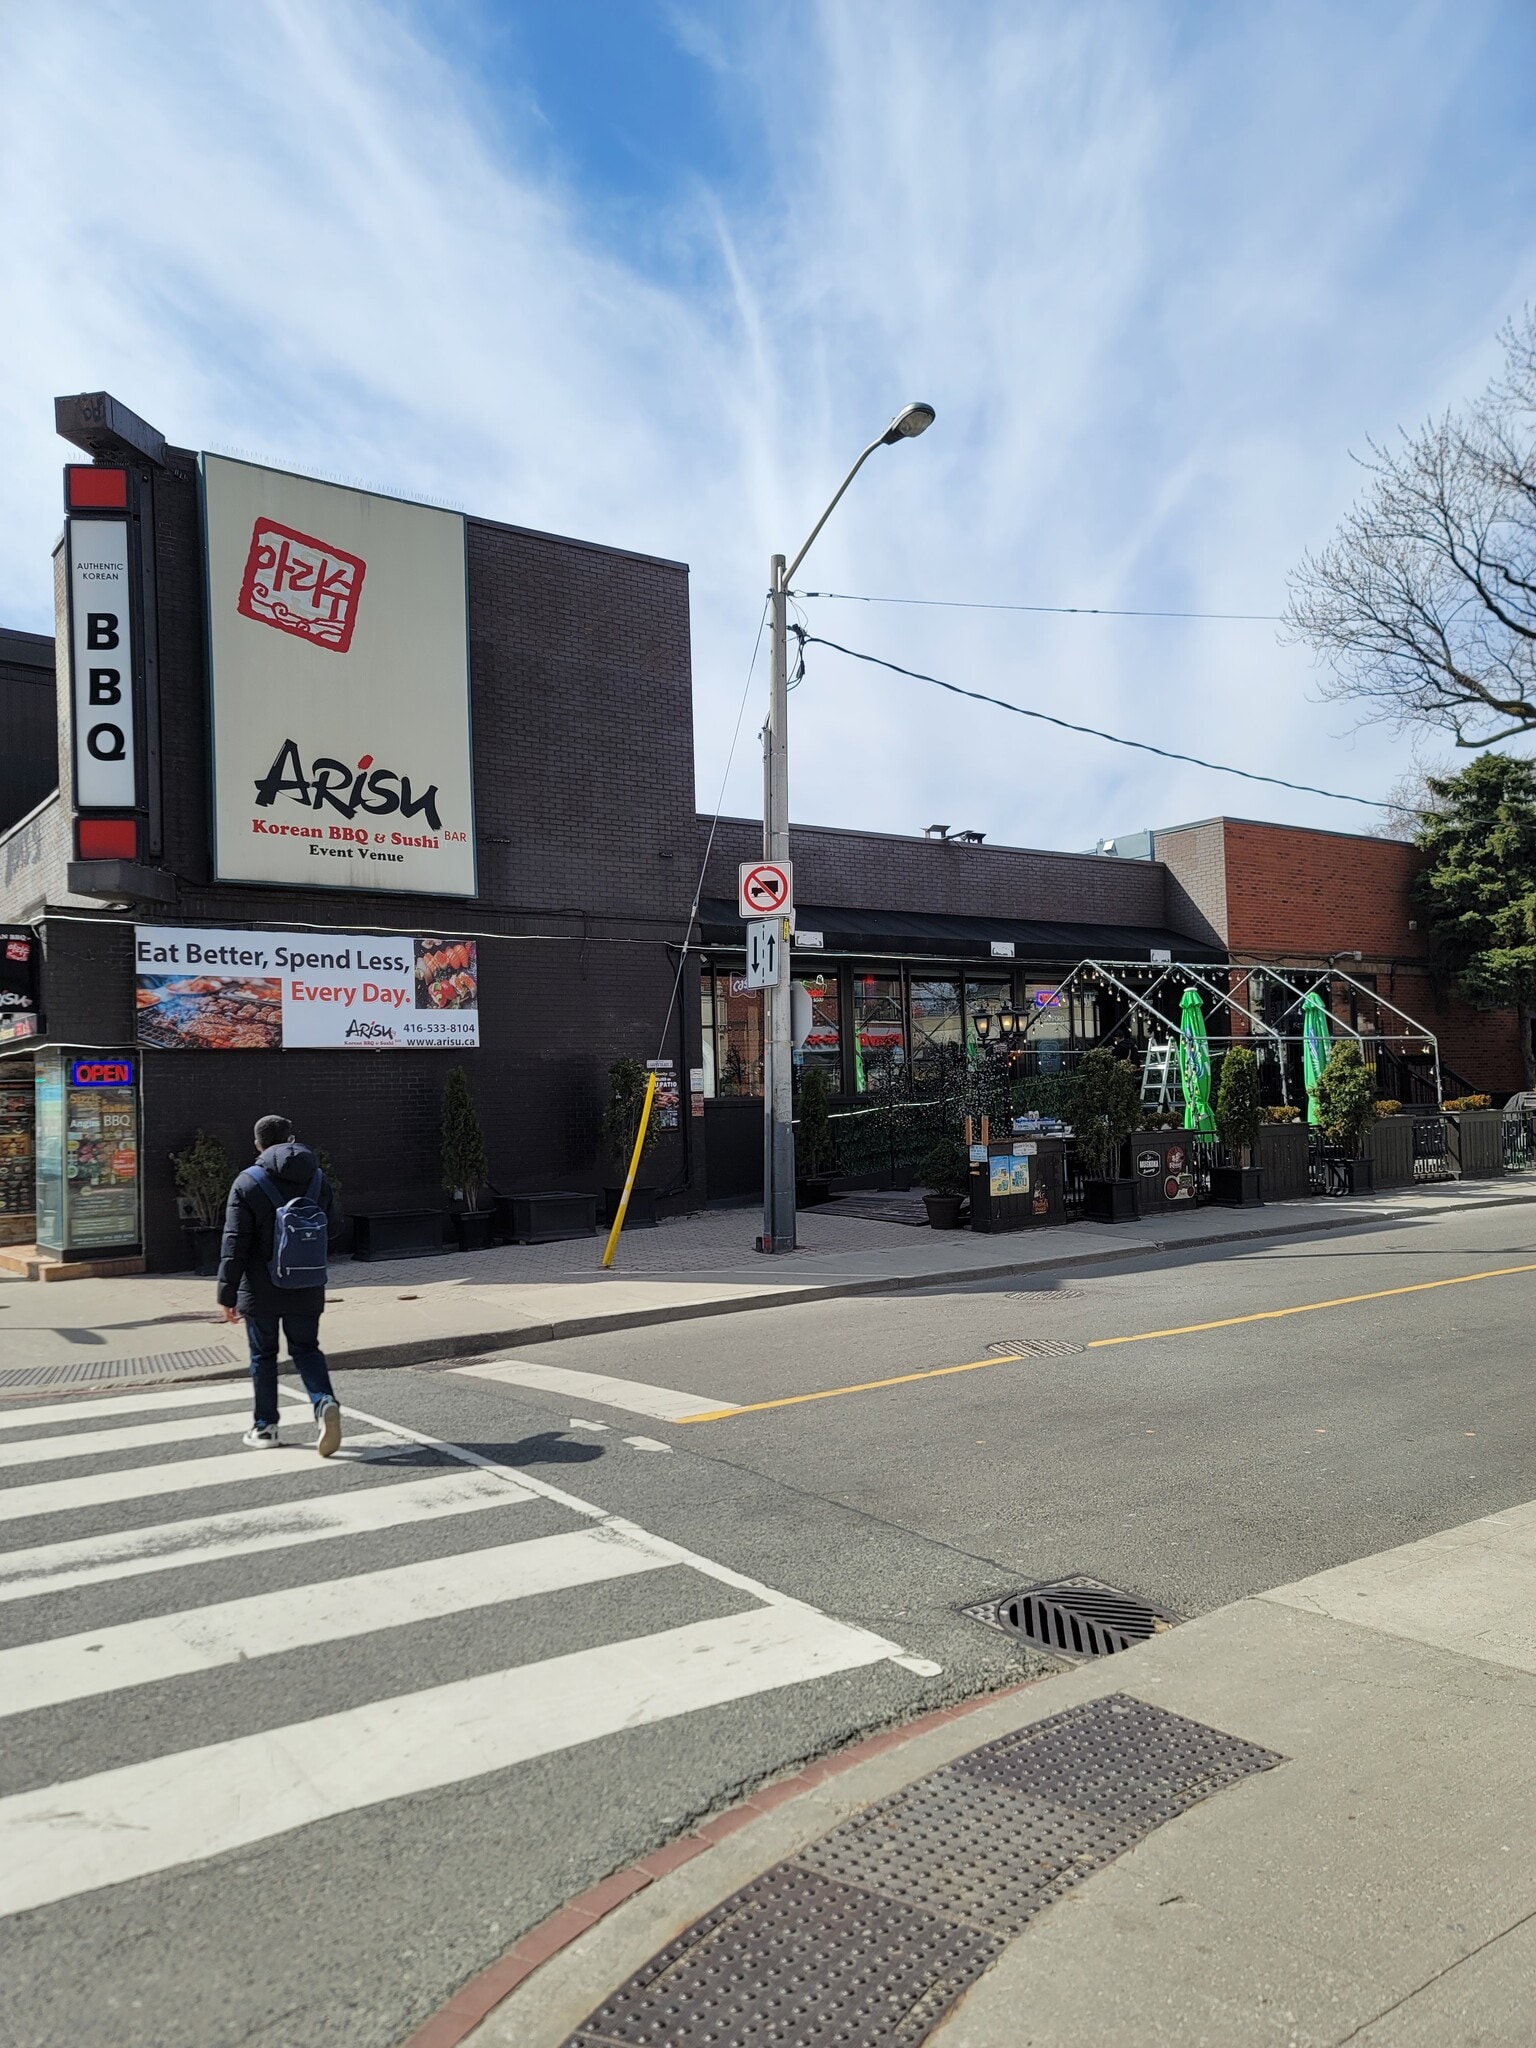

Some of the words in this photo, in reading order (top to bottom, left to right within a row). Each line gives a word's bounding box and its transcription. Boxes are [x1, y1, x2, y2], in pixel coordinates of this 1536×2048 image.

[77, 561, 124, 571] AUTHENTIC
[82, 572, 119, 581] KOREAN
[252, 819, 323, 840] Korean
[328, 826, 369, 845] BBQ
[374, 833, 386, 843] &
[391, 832, 440, 849] Sushi
[444, 830, 467, 842] BAR
[309, 844, 353, 858] Event
[358, 848, 404, 862] Venue
[137, 941, 179, 963] Eat
[186, 943, 269, 970] Better,
[275, 947, 351, 973] Spend
[356, 950, 410, 974] Less,
[291, 981, 357, 1008] Every
[362, 983, 411, 1008] Day.
[403, 1024, 475, 1033] 416-533-8104
[407, 1037, 475, 1046] www.arisu.ca
[77, 1065, 129, 1082] OPEN
[103, 1114, 131, 1127] BBQ
